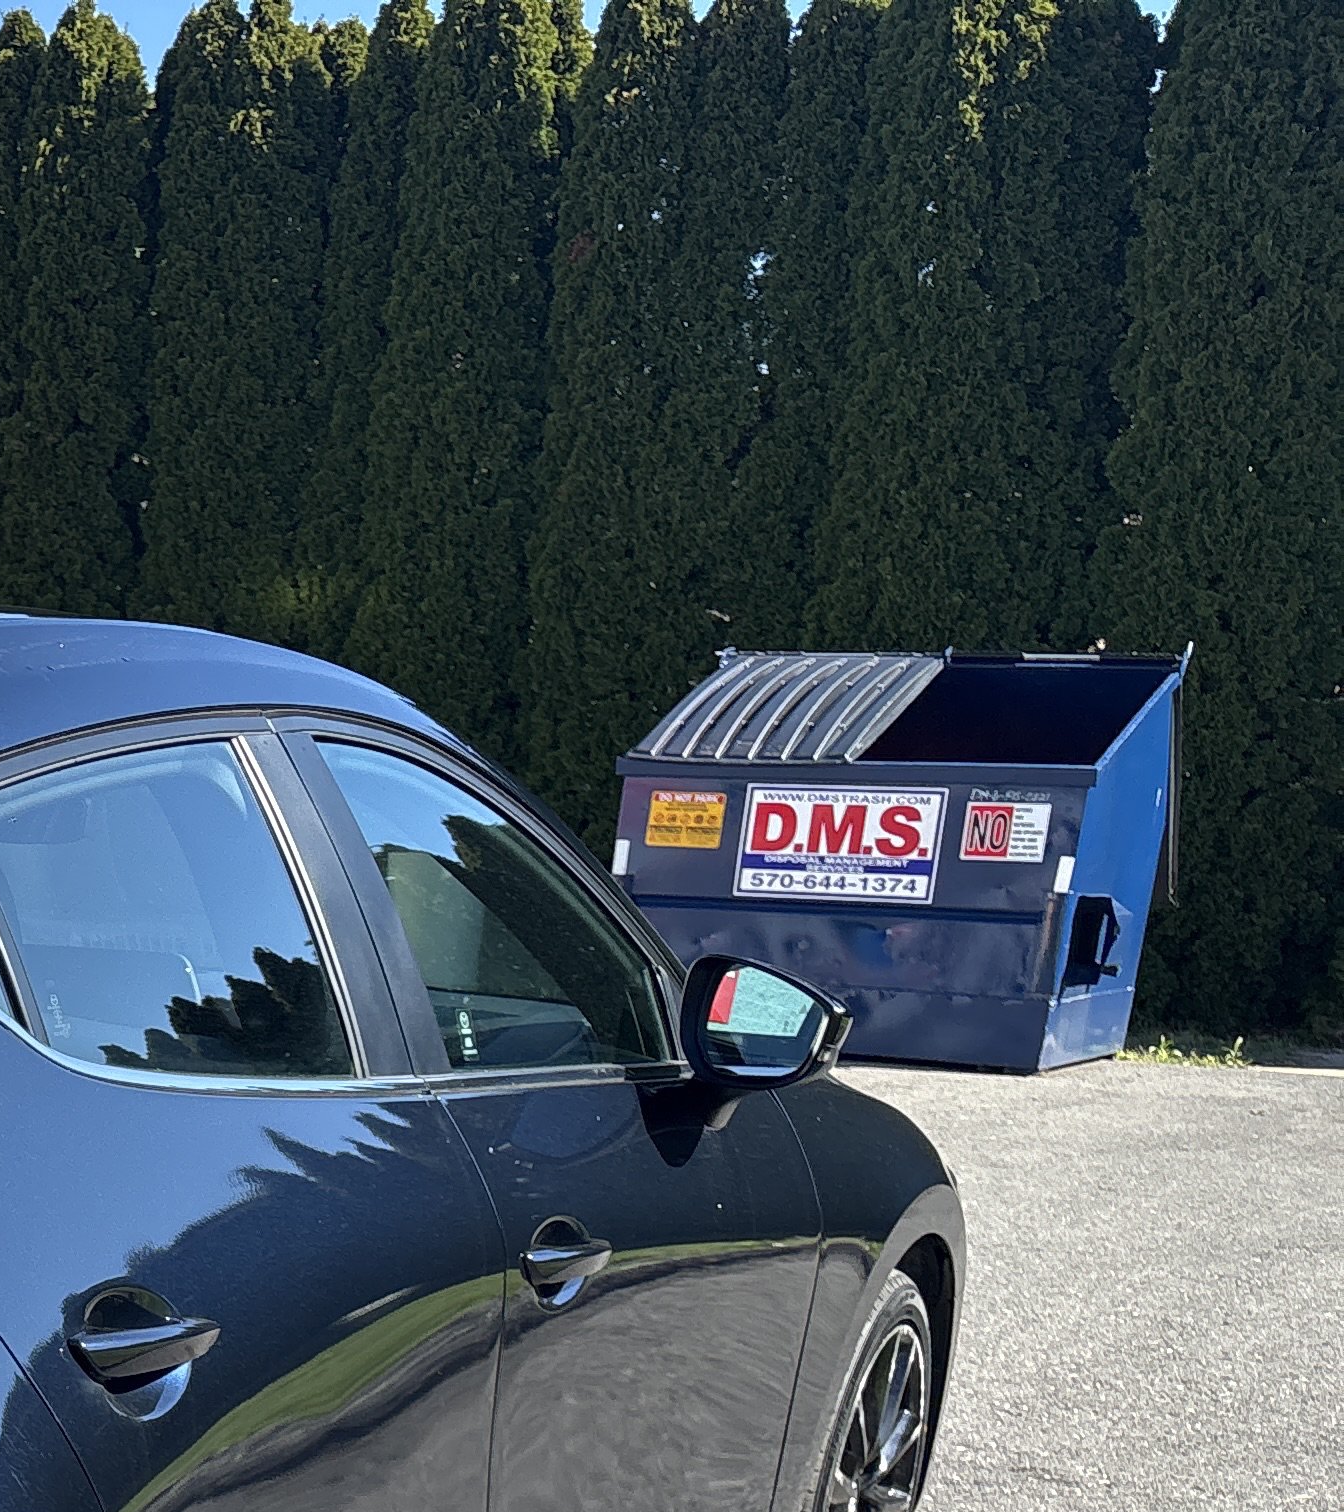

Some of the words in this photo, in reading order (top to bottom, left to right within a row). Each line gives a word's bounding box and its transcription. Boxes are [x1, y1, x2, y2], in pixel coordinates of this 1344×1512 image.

[762, 792, 932, 806] WWW.DMSTRASH.COM
[750, 802, 929, 858] D.M.S.
[966, 809, 1011, 853] NO
[824, 855, 910, 869] MANAGEMENT
[749, 872, 918, 894] 570-644-1374
